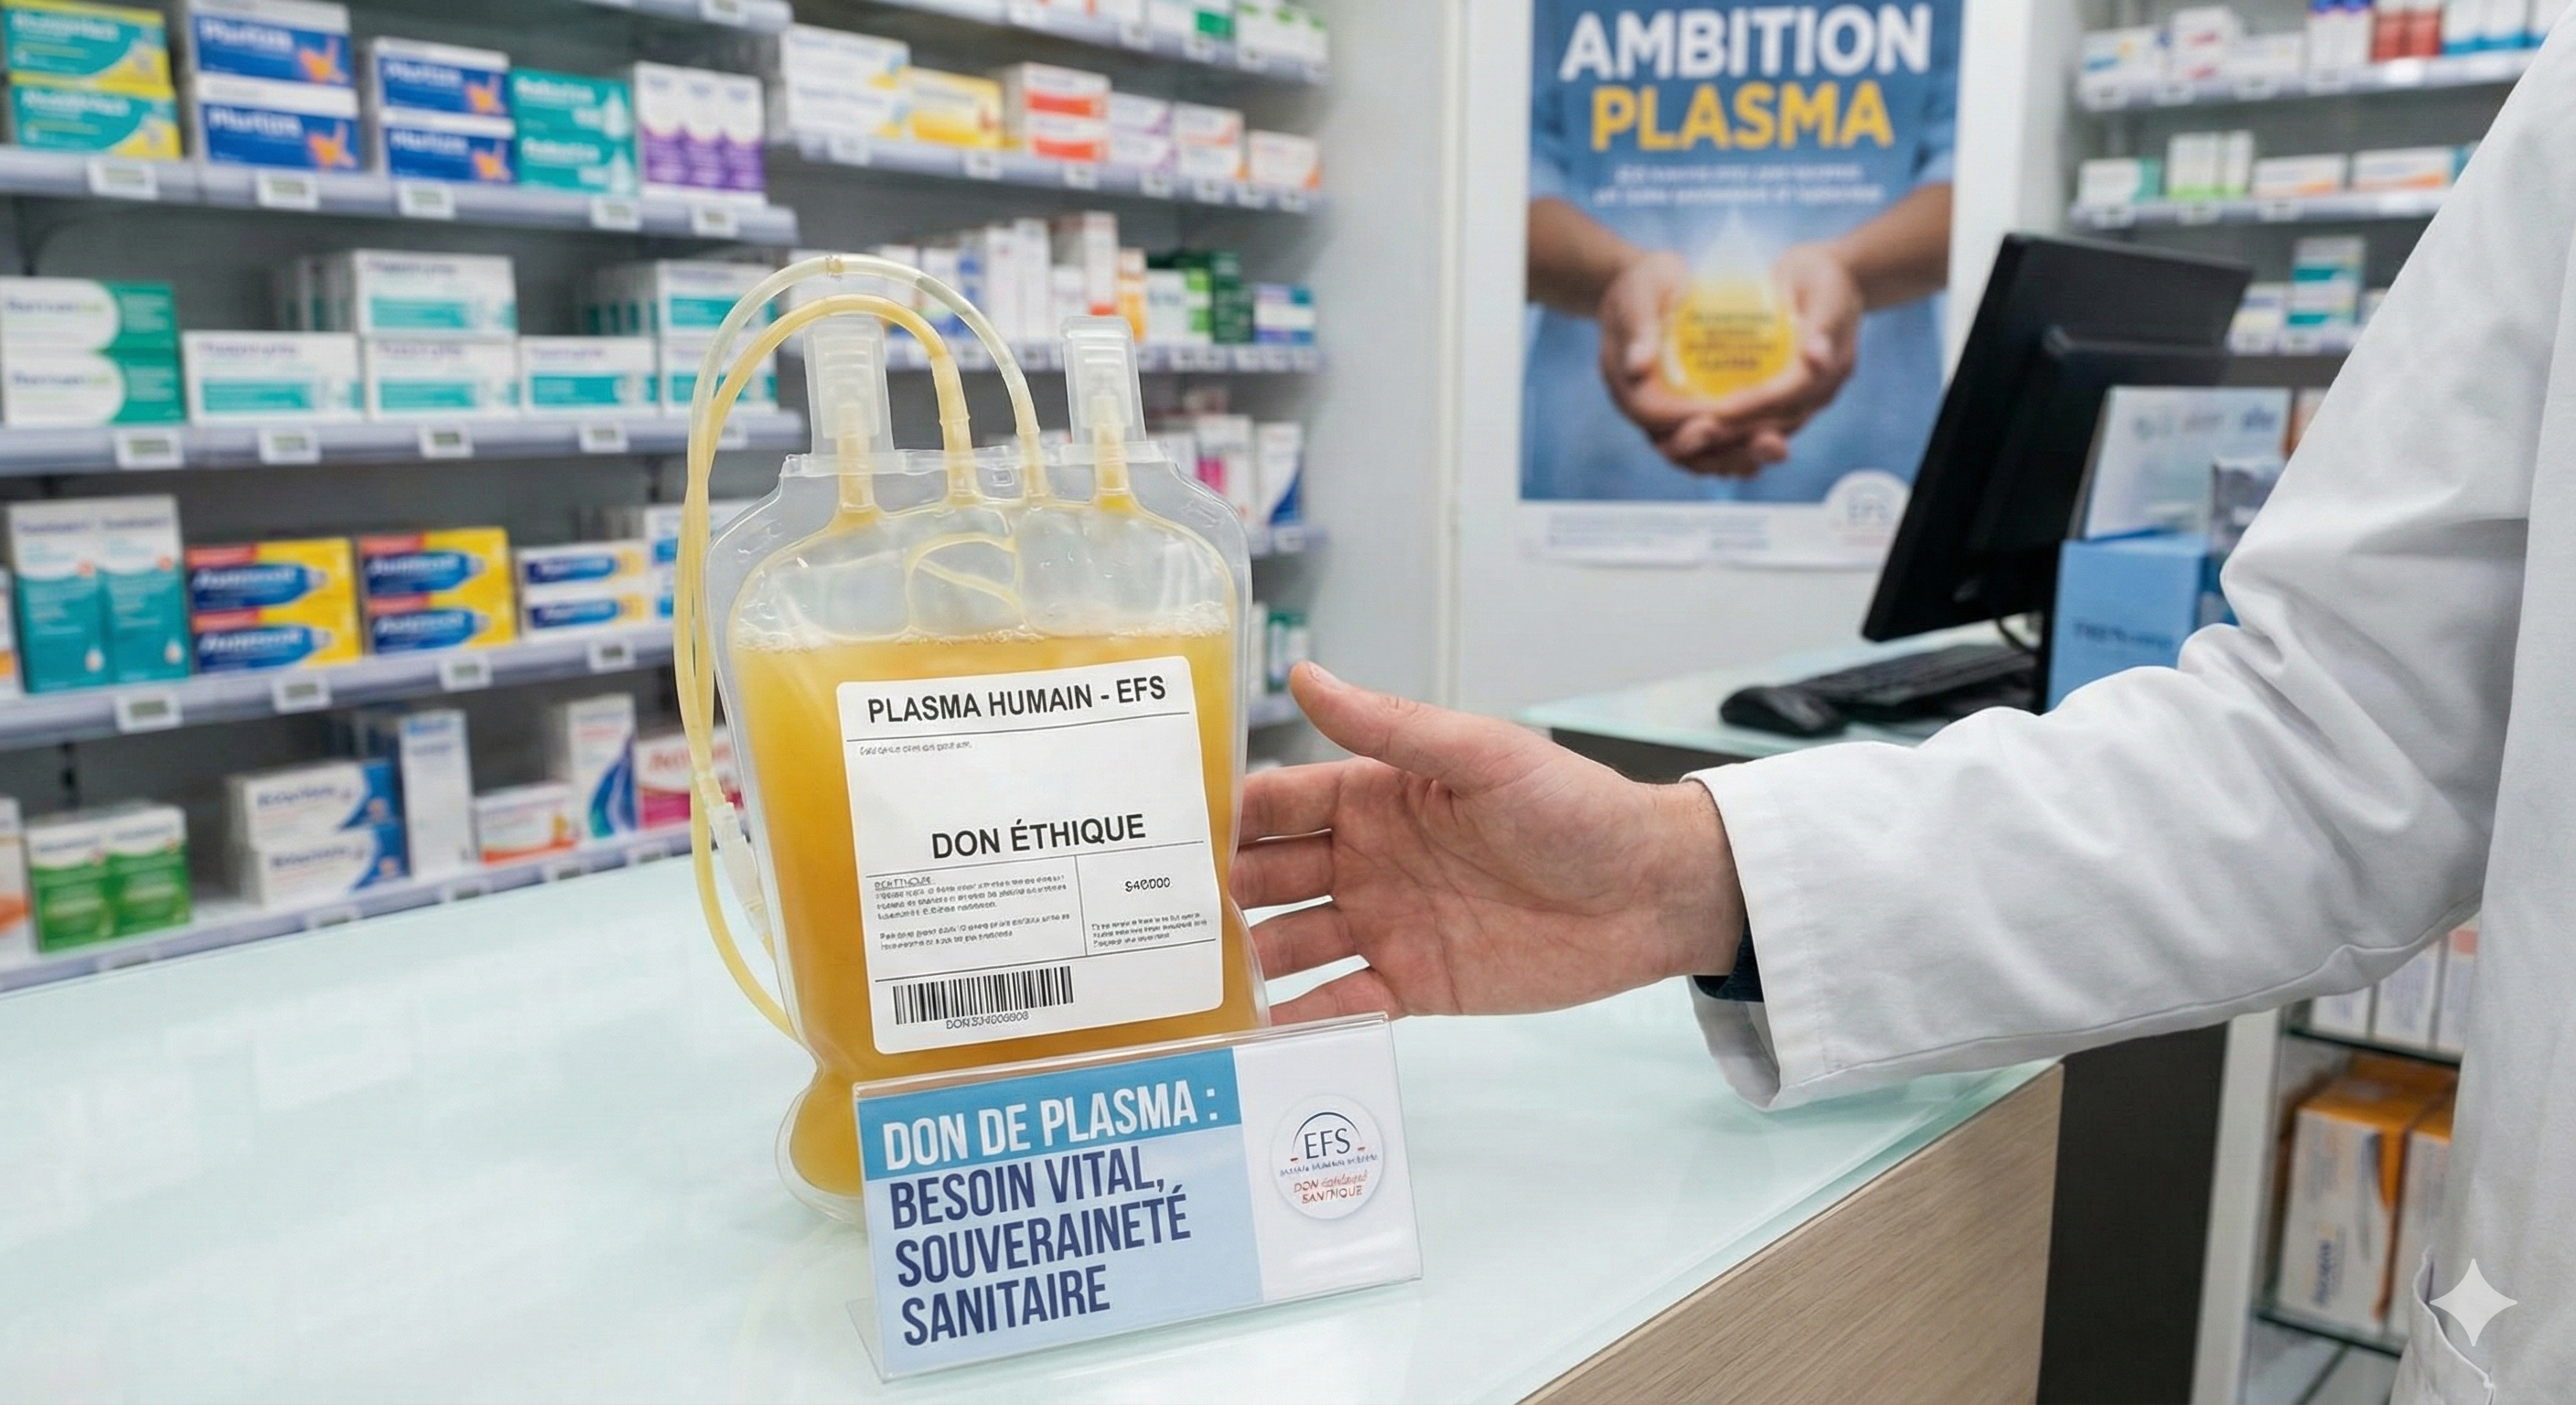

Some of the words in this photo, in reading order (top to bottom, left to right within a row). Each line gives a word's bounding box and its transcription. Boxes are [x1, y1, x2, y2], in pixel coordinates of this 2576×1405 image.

[1559, 4, 1933, 81] AMBITION
[1592, 80, 1894, 152] PLASMA
[867, 692, 982, 724] PLASMA
[988, 683, 1094, 717] HUMAIN
[1116, 675, 1167, 703] EFS
[931, 828, 1002, 860] DON
[1010, 813, 1147, 852] ÉTHIQUE
[883, 1113, 969, 1171] DON
[978, 1103, 1031, 1157] DE
[1041, 1079, 1197, 1147] PLASMA
[1207, 1088, 1218, 1121] :
[1304, 1127, 1352, 1161] EFS
[889, 1162, 1036, 1230] BESOIN
[1044, 1145, 1165, 1204] VITAL,
[1293, 1178, 1319, 1194] DON
[896, 1184, 1192, 1288] SOUVERAINETÉ
[902, 1264, 1111, 1346] SANITAIRE
